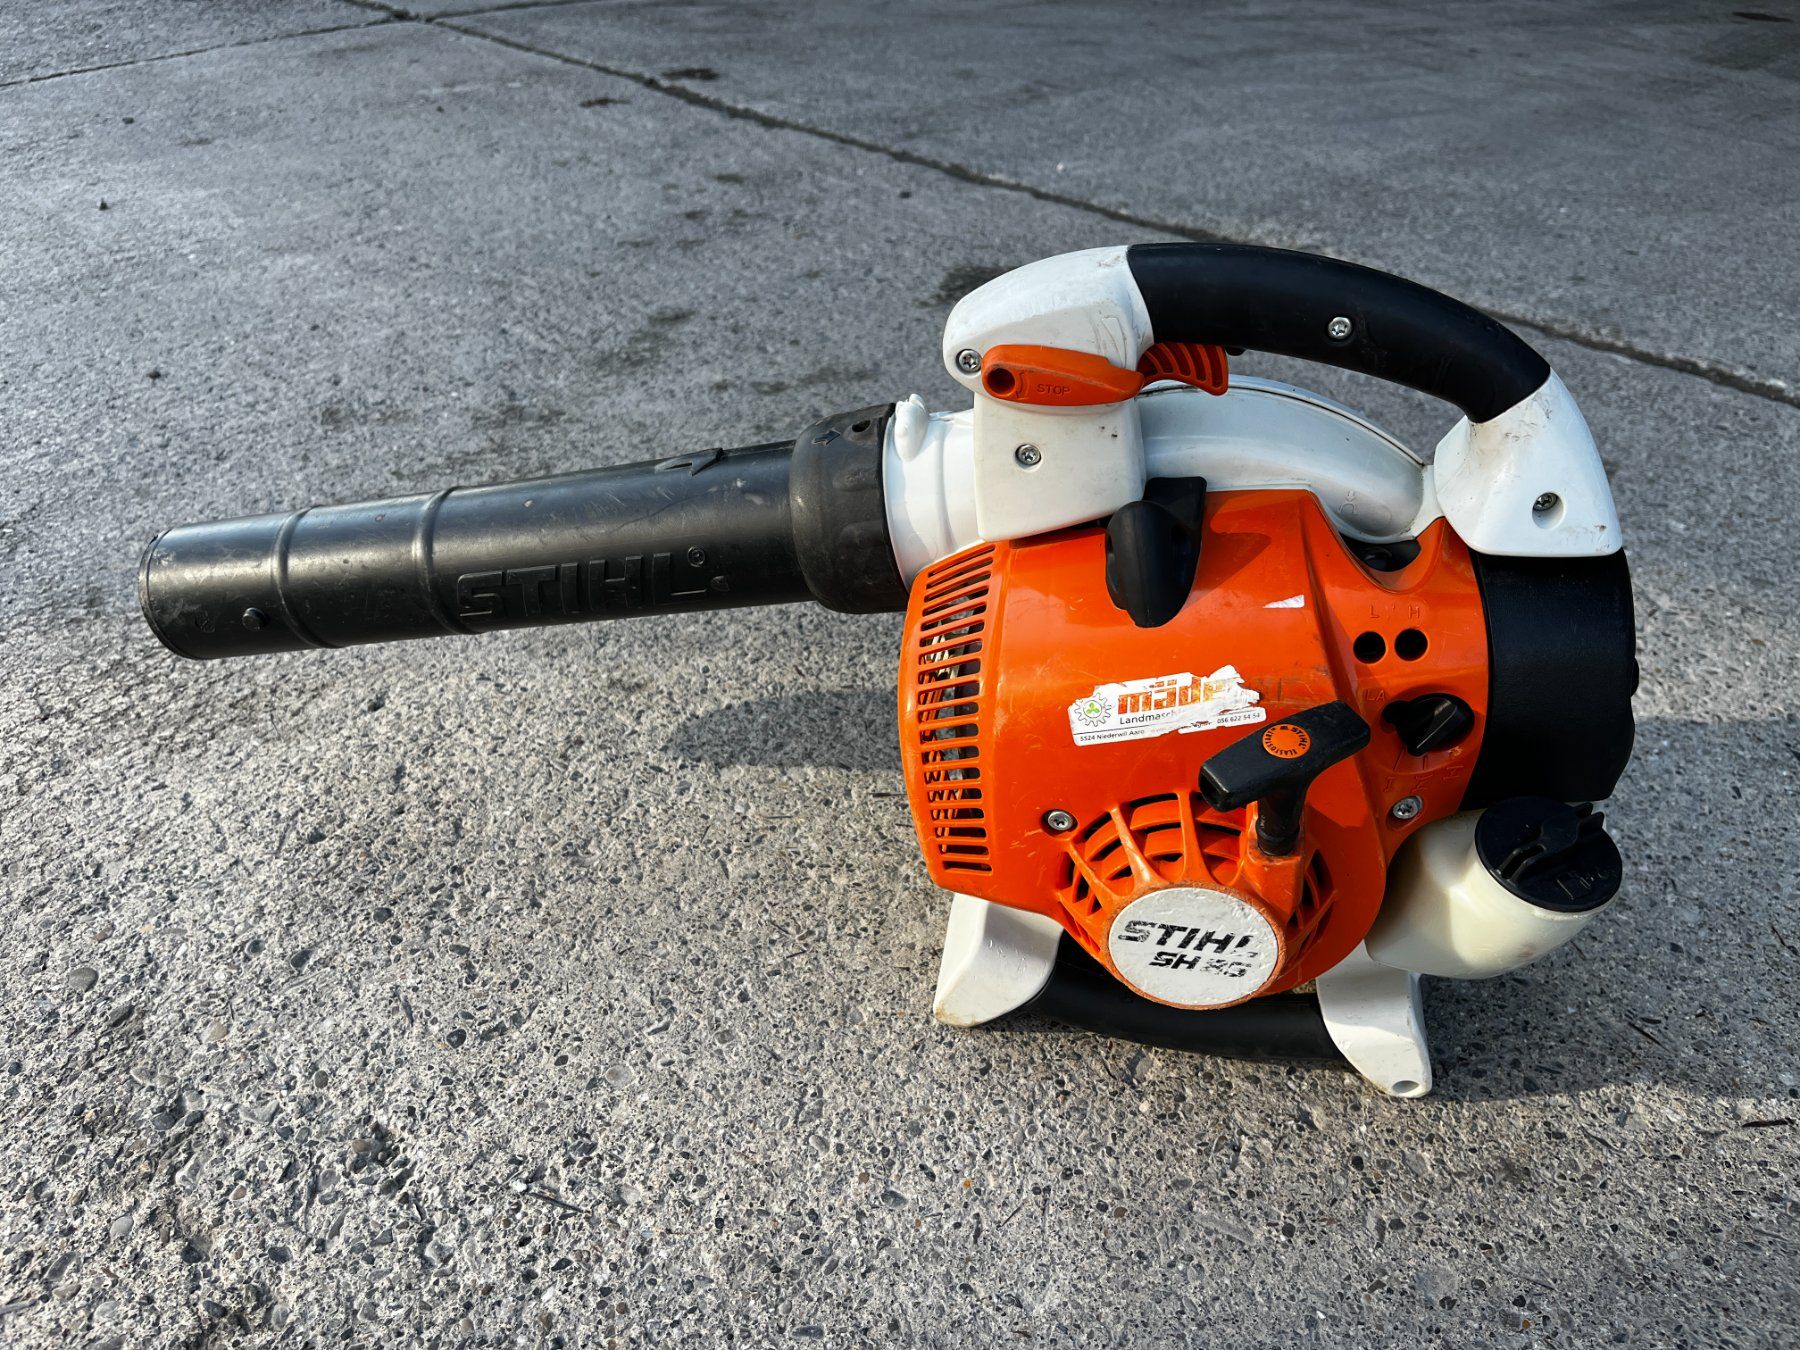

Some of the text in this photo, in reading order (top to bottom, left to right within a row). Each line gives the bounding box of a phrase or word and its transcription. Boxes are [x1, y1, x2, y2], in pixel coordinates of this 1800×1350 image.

[1036, 383, 1071, 397] STOP
[457, 553, 706, 617] STIHL
[1369, 605, 1420, 619] L H
[1229, 715, 1241, 723] 622
[1079, 733, 1096, 742] 5524
[1096, 731, 1128, 740] Niederwil
[1148, 951, 1202, 970] SH
